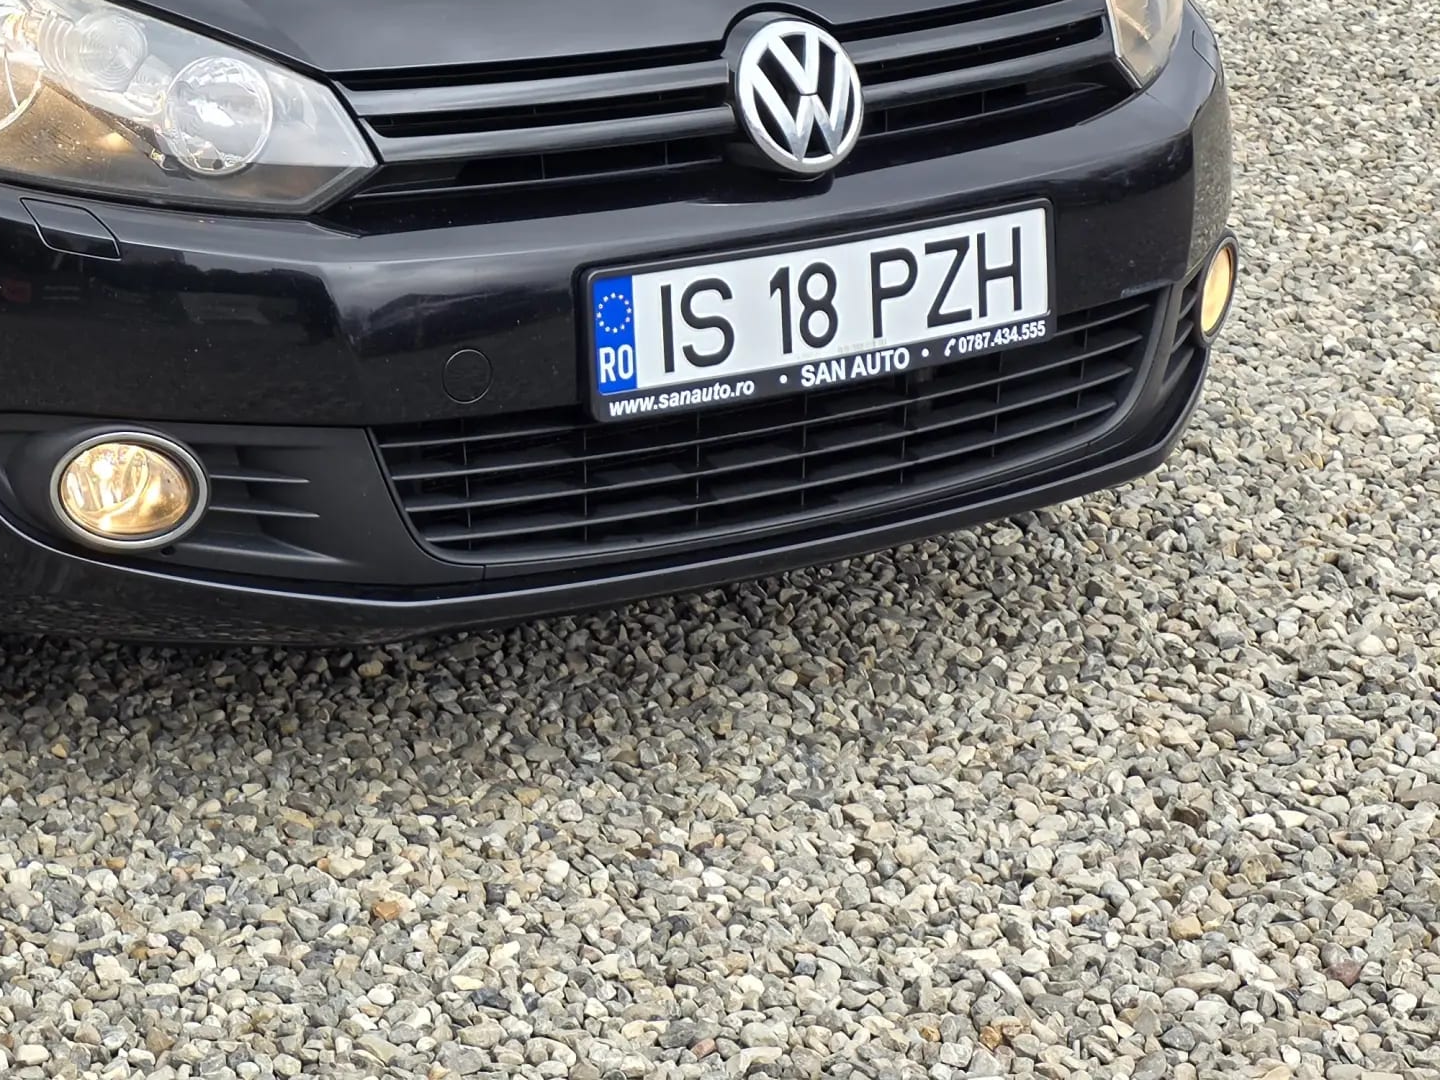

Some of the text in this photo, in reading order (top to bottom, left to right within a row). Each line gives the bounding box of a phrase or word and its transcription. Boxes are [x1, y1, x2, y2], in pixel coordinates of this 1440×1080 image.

[660, 226, 1023, 373] IS 18 PZH
[599, 344, 634, 383] RO
[609, 320, 1047, 416] www.sanauto.ro SAN AUTO 0787.434.555
